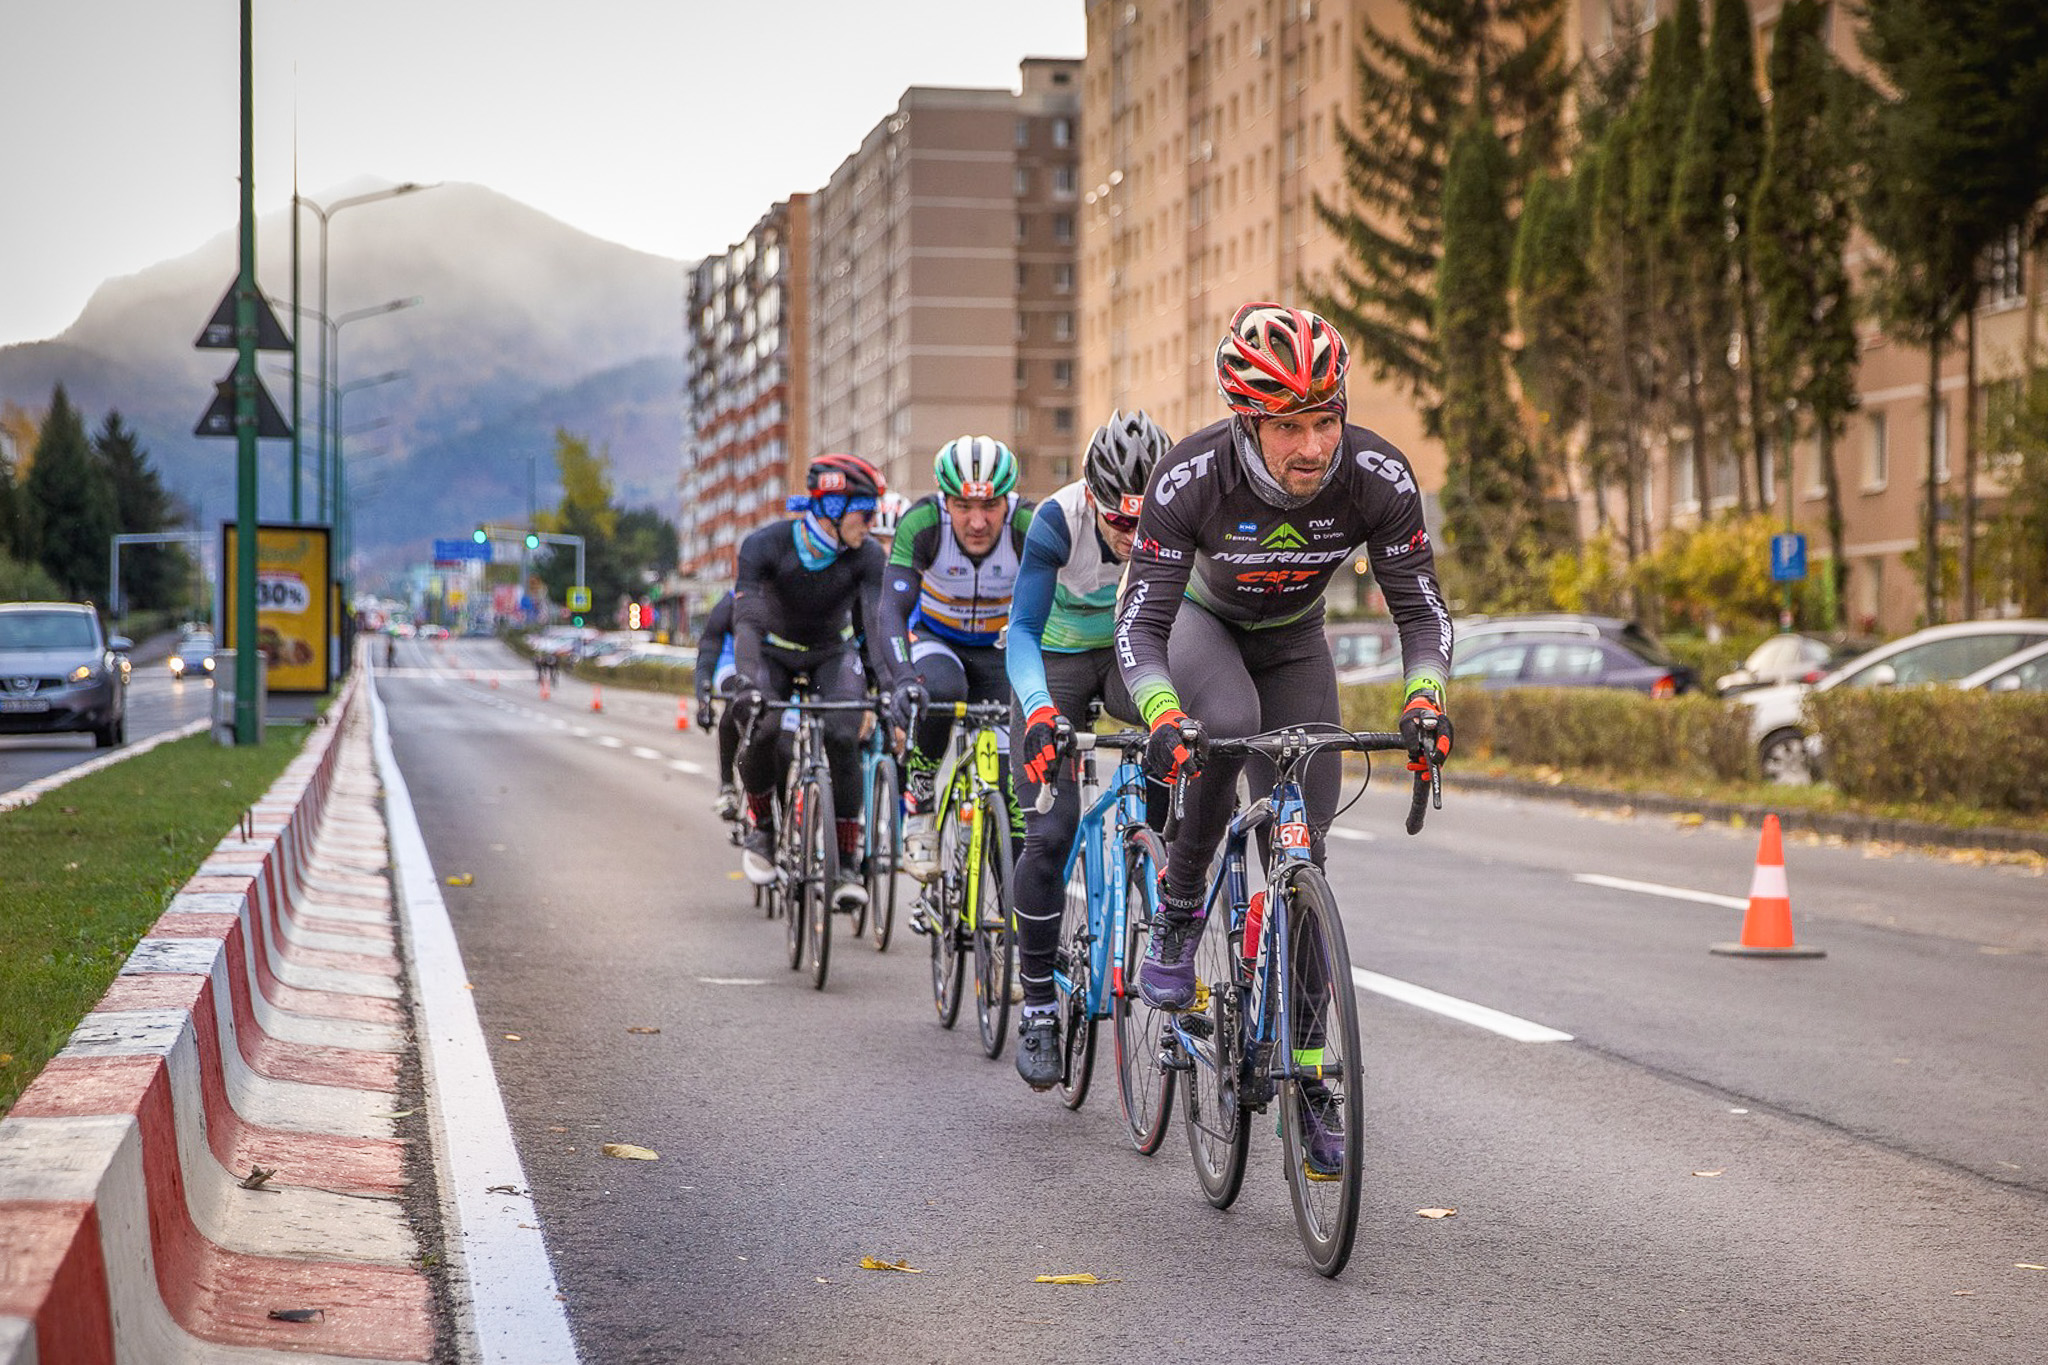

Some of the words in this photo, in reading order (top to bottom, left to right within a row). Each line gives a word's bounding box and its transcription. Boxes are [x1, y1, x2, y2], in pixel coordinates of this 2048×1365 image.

[1155, 449, 1216, 506] CST
[1356, 450, 1417, 494] CST
[1128, 499, 1144, 513] 9
[1211, 546, 1352, 565] MERIDA
[1116, 580, 1150, 669] MERIDA
[1281, 825, 1306, 845] 67
[1113, 845, 1124, 954] FOCUS
